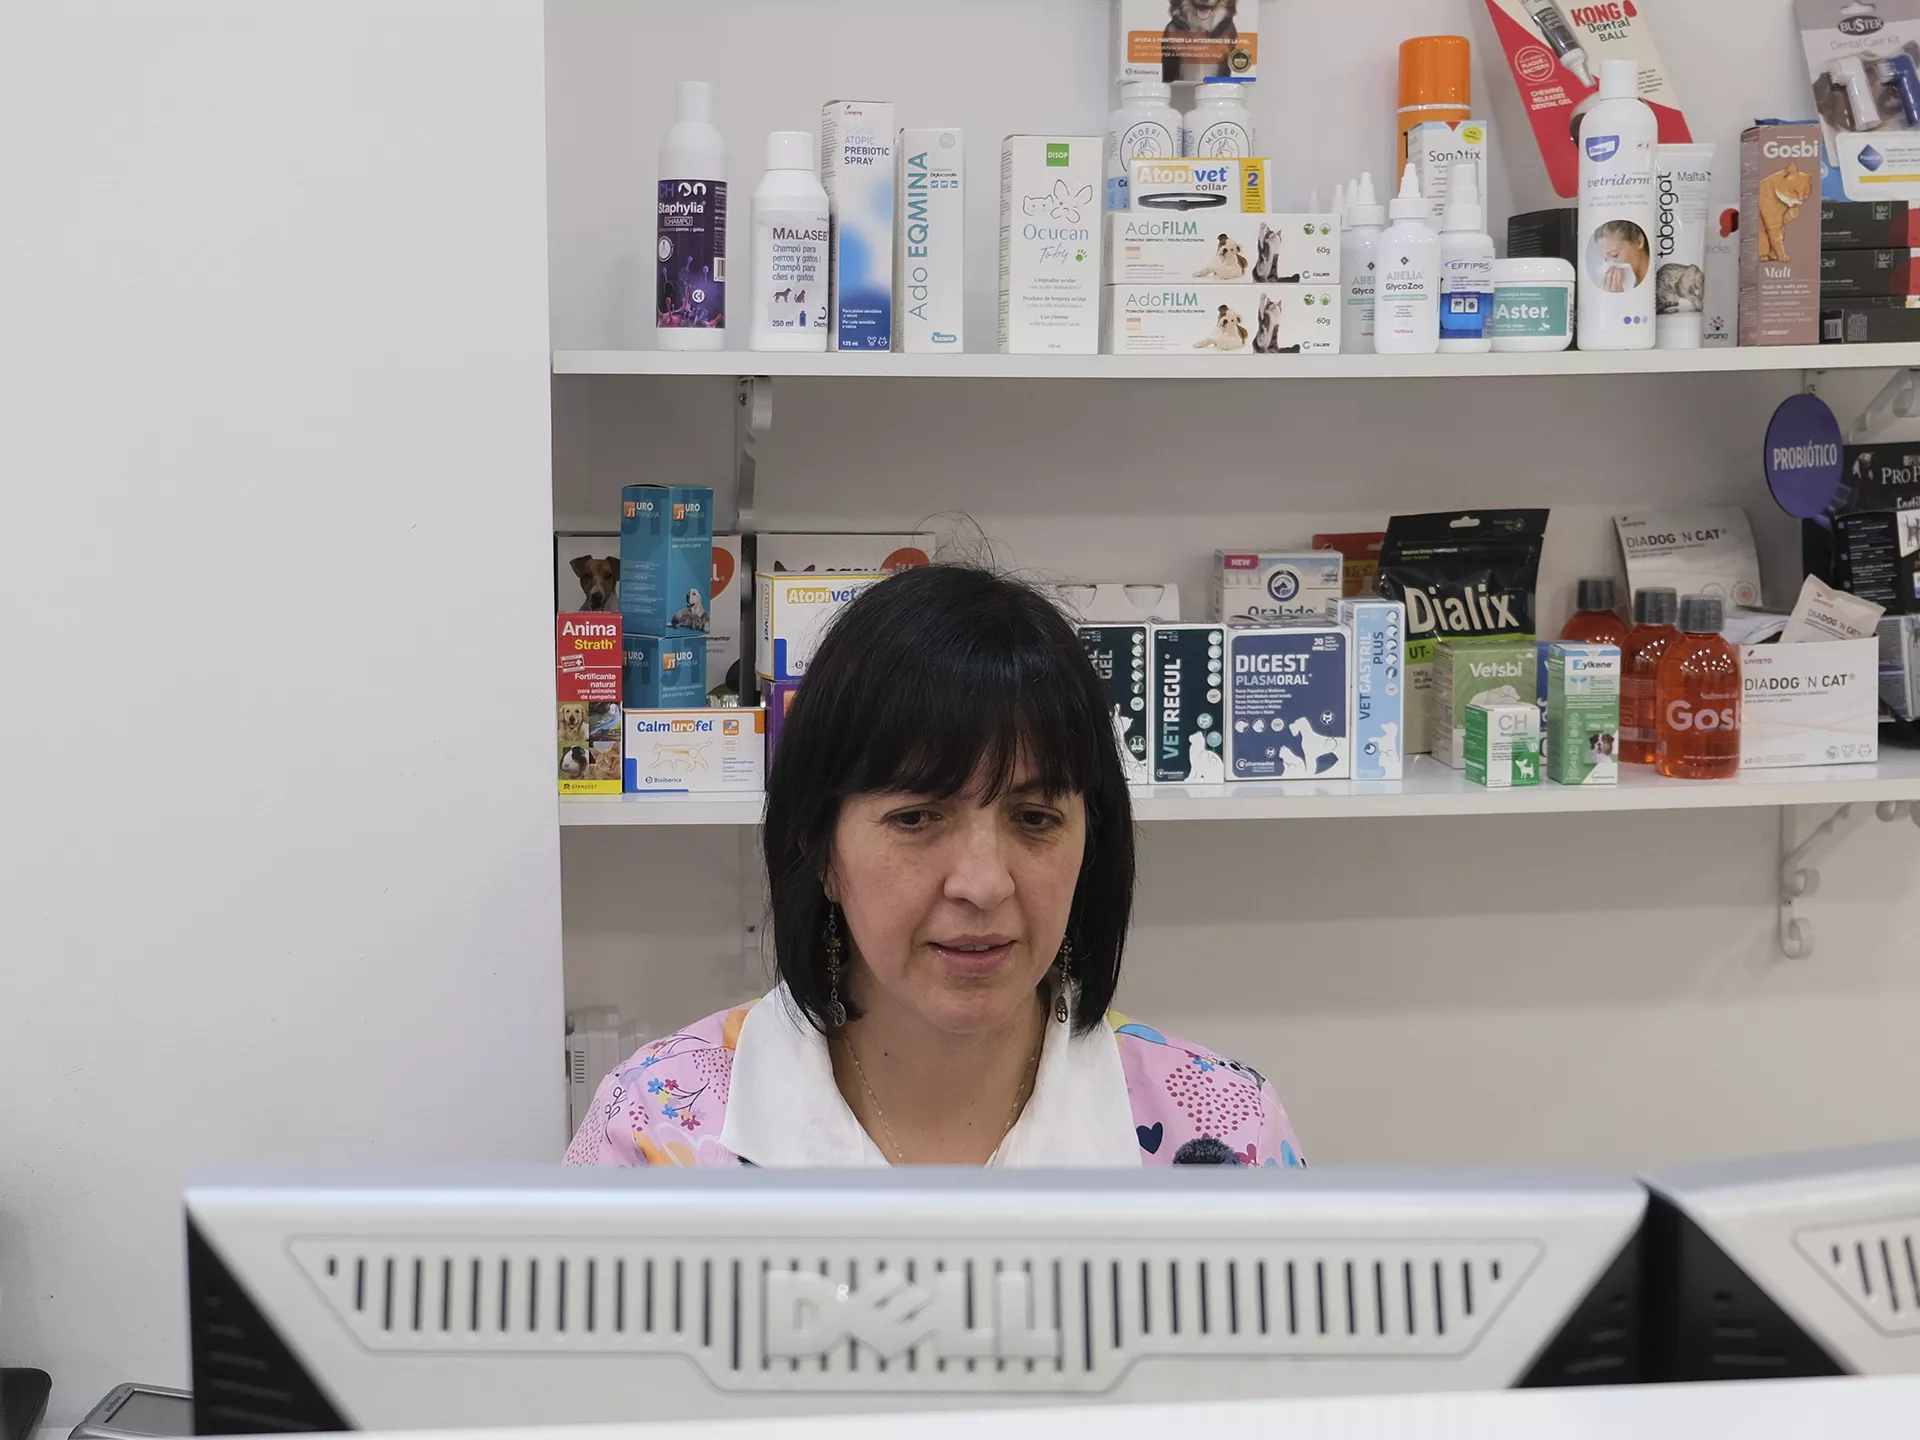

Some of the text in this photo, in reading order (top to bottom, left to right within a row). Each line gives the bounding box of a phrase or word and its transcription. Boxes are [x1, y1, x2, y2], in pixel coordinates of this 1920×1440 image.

[1571, 2, 1622, 27] KONG
[1587, 17, 1631, 33] Dental
[1840, 18, 1883, 32] BUSTER
[1599, 31, 1628, 42] BALL
[1830, 35, 1900, 50] Dental Care Kit
[844, 135, 875, 145] ATOPIC
[844, 146, 890, 156] PREBIOTIC
[1047, 151, 1068, 159] DISOP
[1763, 140, 1819, 159] Gosbi
[844, 156, 874, 166] SPRAY
[1138, 166, 1228, 185] Atopivet
[1247, 172, 1259, 187] 2
[1587, 173, 1651, 188] vetriderm
[1677, 171, 1706, 181] Malta
[1195, 183, 1228, 191] collar
[658, 201, 704, 216] Staphylia
[1657, 171, 1679, 259] tabergat
[772, 227, 828, 242] MALASEB
[1023, 224, 1089, 241] Ocucan
[1125, 221, 1198, 236] AdoFILM
[907, 152, 929, 321] Ado EQMINA
[772, 244, 816, 254] Champú para
[1316, 246, 1331, 256] 60g
[772, 255, 795, 263] perros
[1451, 262, 1489, 270] EFFIPRO
[802, 265, 816, 273] para
[1386, 270, 1424, 281] ABELIA
[1764, 266, 1792, 278] Malt
[796, 273, 814, 282] gatos
[1385, 282, 1424, 292] GlycoZoo
[1126, 292, 1198, 307] AdoFILM
[1496, 303, 1549, 320] Aster
[1316, 317, 1331, 326] 60g
[1773, 440, 1838, 471] PROBIÓTICO
[1881, 467, 1912, 485] PRO
[636, 502, 654, 511] URO
[684, 503, 701, 512] URO
[1625, 533, 1677, 548] DIADOG
[1231, 559, 1251, 567] NEW
[1403, 583, 1520, 634] Dialix
[1807, 608, 1838, 627] DIADOG
[562, 620, 617, 637] Anima
[574, 638, 614, 650] Strath
[1313, 637, 1324, 646] 30
[1373, 631, 1385, 665] PLUS
[628, 651, 644, 661] URO
[676, 651, 693, 660] URO
[1099, 649, 1113, 680] GEL
[1235, 653, 1310, 673] DIGEST
[1469, 662, 1523, 678] Vetsbi
[1573, 659, 1612, 670] Zylkene
[574, 672, 617, 680] Fortificante
[1235, 674, 1309, 686] PLASMORAL
[1744, 677, 1800, 691] DIADOG
[1162, 657, 1181, 760] VETREGUL
[637, 720, 713, 733] Calmurofel
[1498, 714, 1528, 731] CH
[761, 1268, 1062, 1358] DELL
